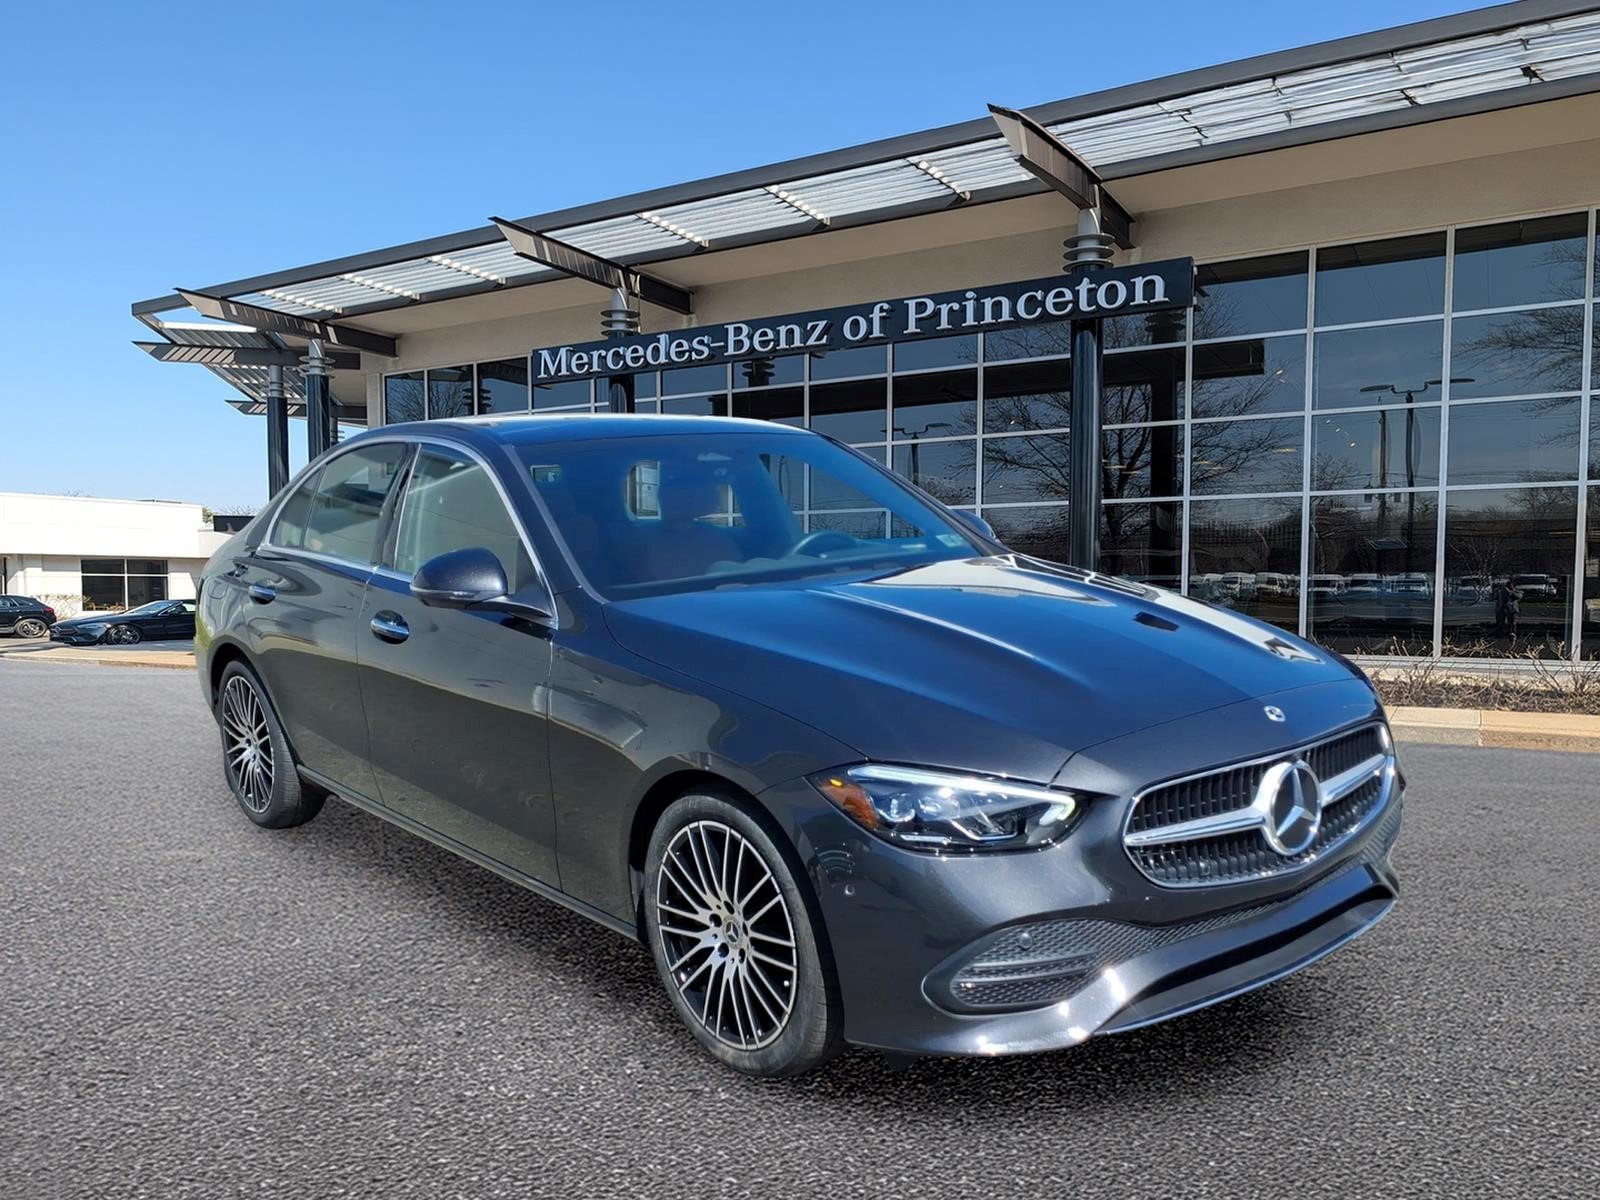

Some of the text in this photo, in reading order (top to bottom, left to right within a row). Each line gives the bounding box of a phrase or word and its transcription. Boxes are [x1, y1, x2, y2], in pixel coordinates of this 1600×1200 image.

[537, 273, 1169, 378] Mercedes-Benz of Princeton
